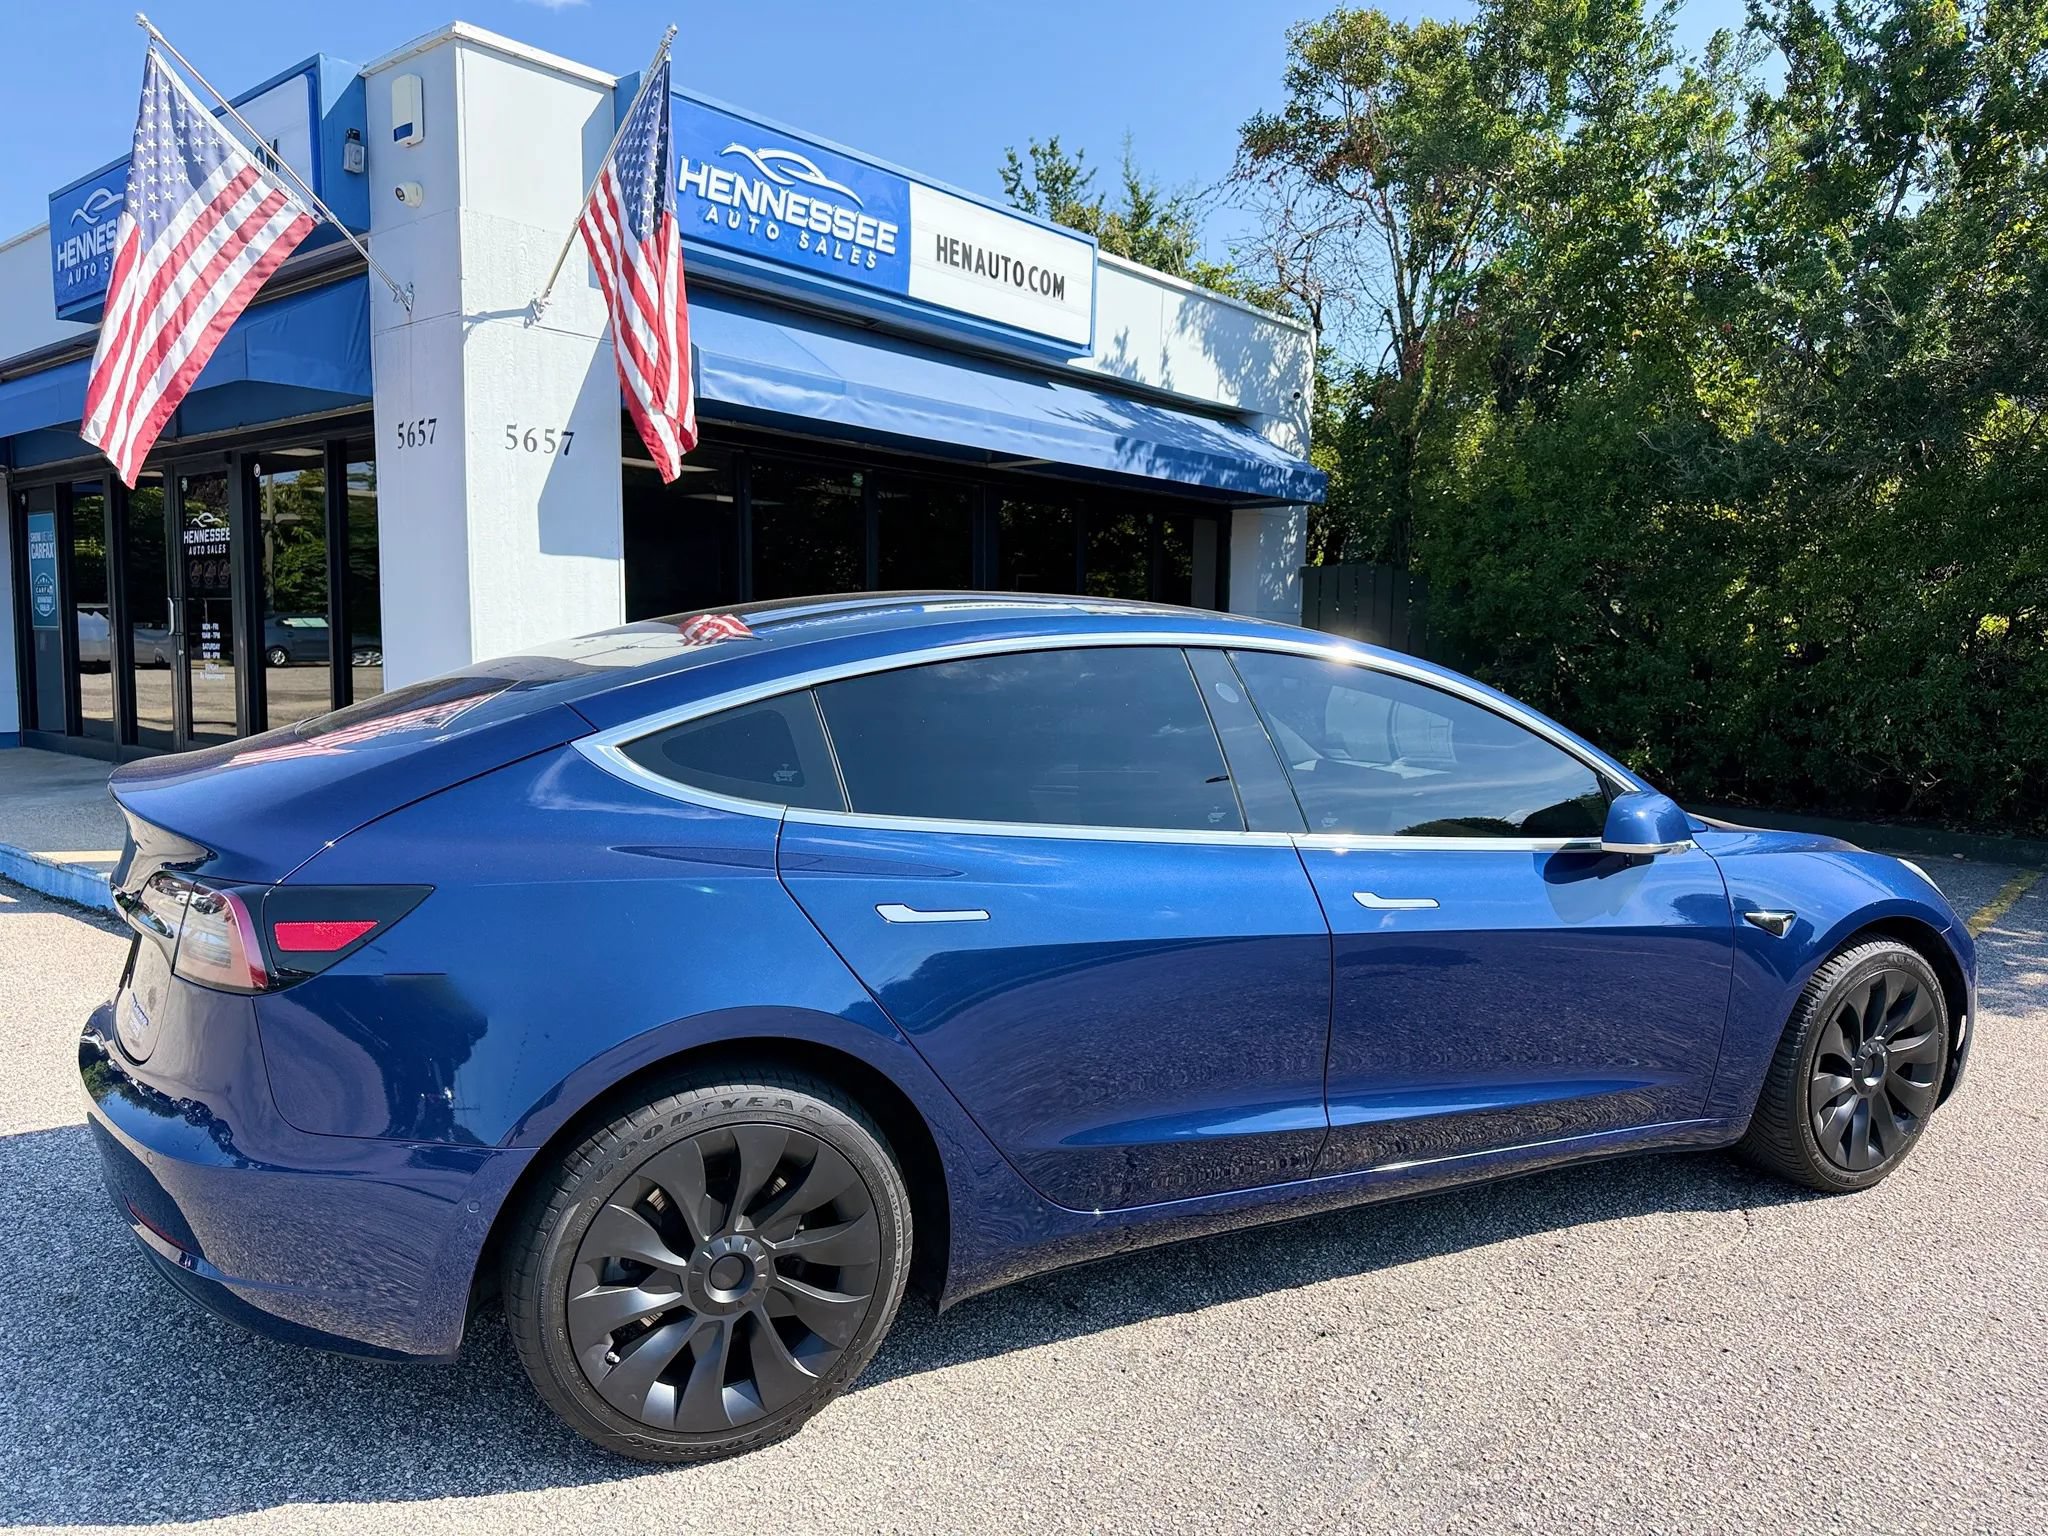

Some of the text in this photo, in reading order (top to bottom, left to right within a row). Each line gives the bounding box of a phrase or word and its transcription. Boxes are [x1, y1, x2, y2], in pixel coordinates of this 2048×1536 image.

[677, 155, 899, 256] HENNESSEE
[57, 218, 117, 272] HENNES
[705, 203, 877, 270] AUTO SALES
[67, 262, 97, 287] AUTO
[397, 417, 438, 450] 5657
[504, 422, 575, 456] 5657
[31, 542, 55, 560] CARFAX
[183, 527, 231, 545] HENNESSEE
[188, 543, 226, 556] AUTO SALES
